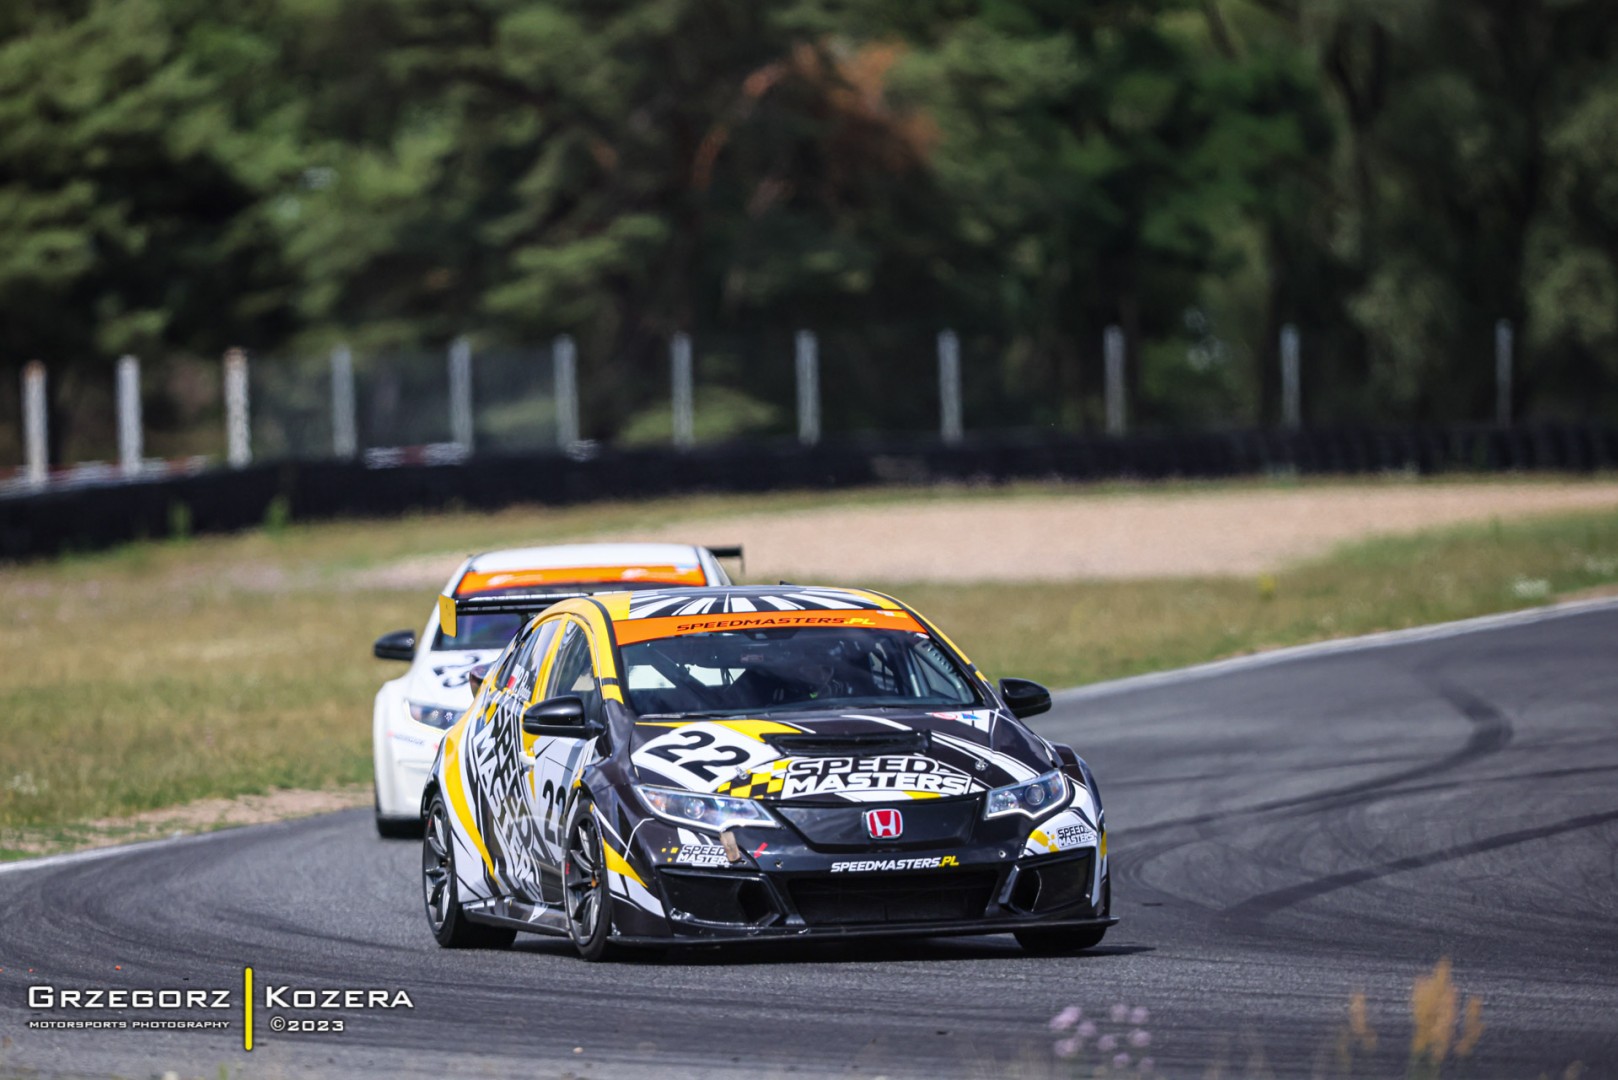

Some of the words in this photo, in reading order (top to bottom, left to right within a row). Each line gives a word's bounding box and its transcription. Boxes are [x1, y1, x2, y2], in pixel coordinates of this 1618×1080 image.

[676, 617, 877, 632] SPEEDMASTERS.PL
[644, 730, 751, 784] 22
[790, 757, 936, 776] SPEED
[780, 771, 968, 800] MASTERS
[1057, 824, 1086, 839] SPEED
[830, 855, 960, 872] SPEEDMASTERS.PL
